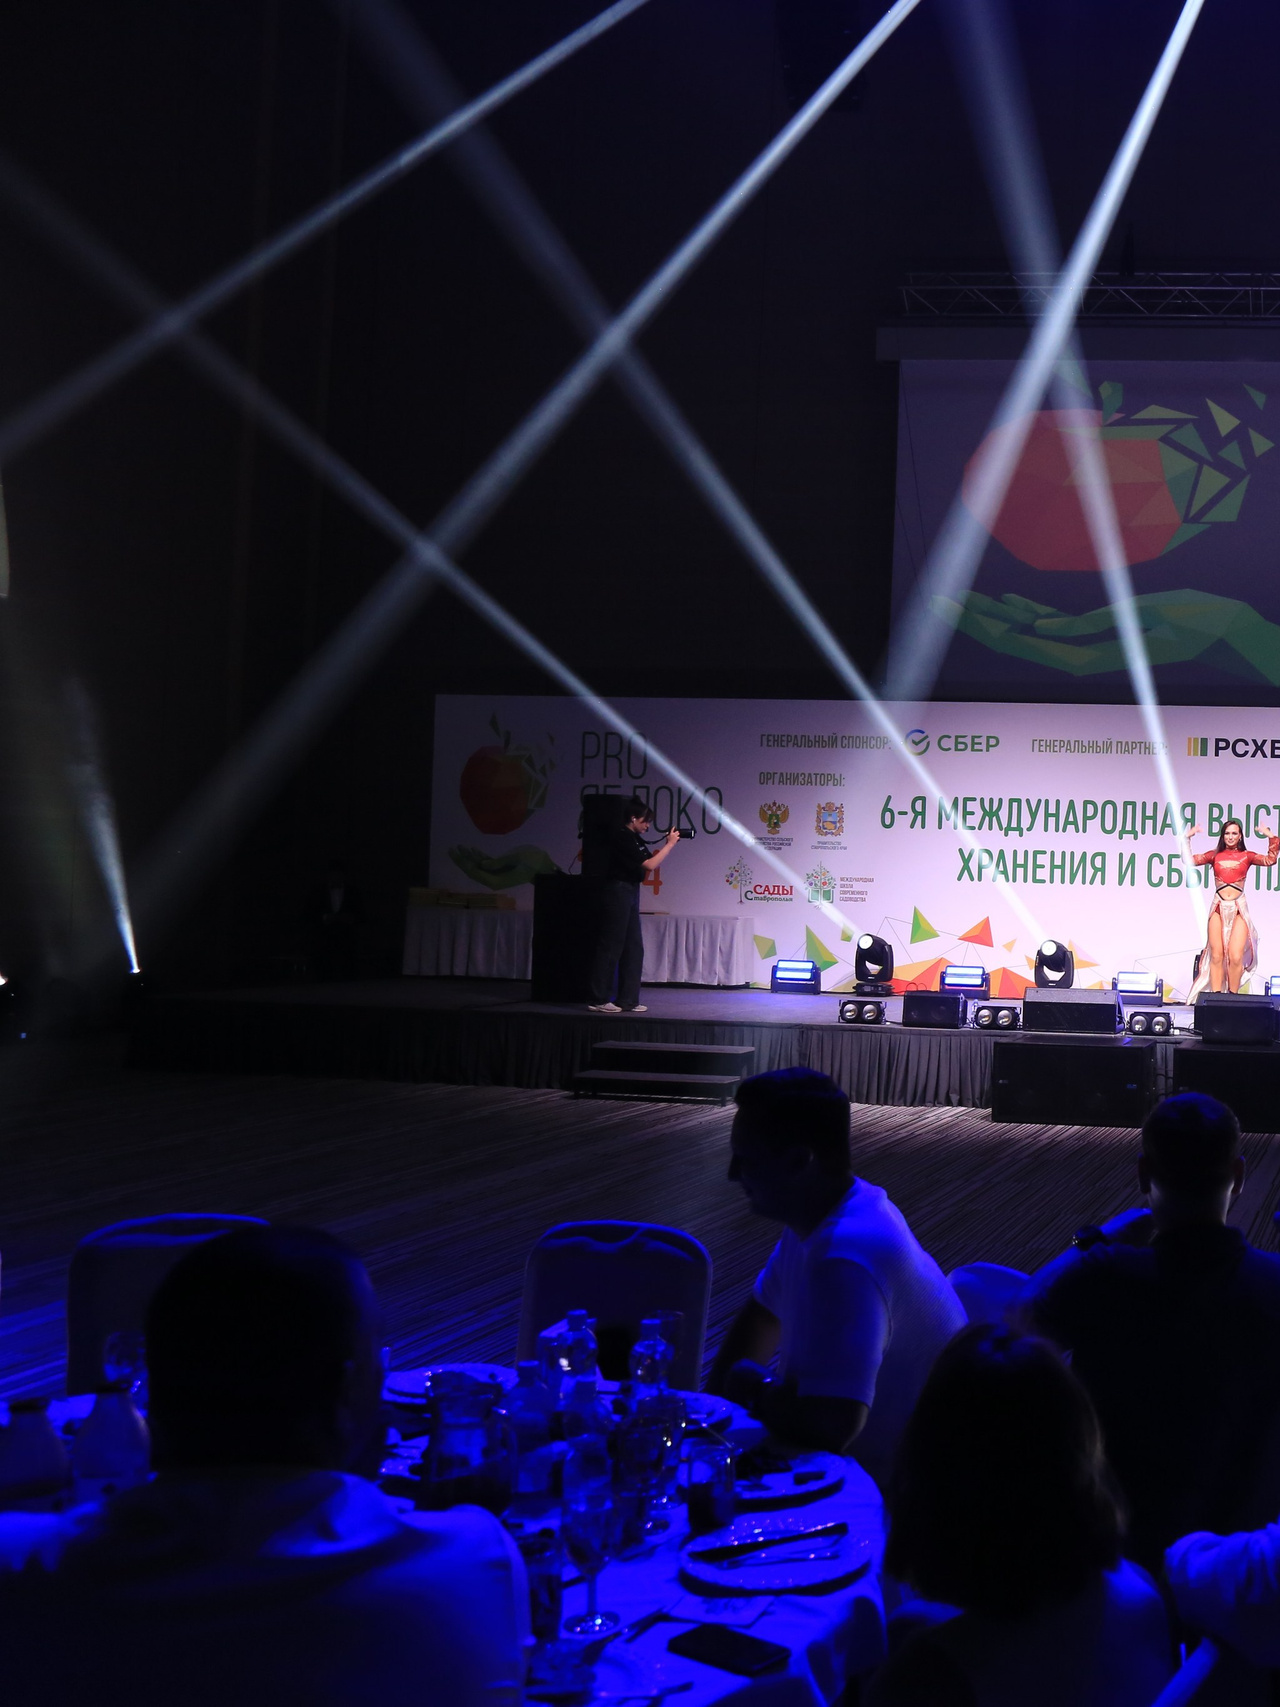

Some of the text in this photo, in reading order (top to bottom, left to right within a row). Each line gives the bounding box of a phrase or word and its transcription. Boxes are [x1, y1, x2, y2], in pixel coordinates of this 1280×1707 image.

[760, 732, 892, 750] ГЕНЕРАЛЬНЫЙ СПОНСОР:
[937, 734, 1000, 752] СБЕР
[1031, 737, 1113, 755] ГЕНЕРАЛЬНЫЙ
[580, 730, 649, 781] PRO
[758, 771, 846, 787] ОРГАНИЗАТОРЫ:
[880, 795, 927, 830] 6-Я
[937, 796, 1197, 840] МЕЖДУНАРОДНАЯ
[957, 847, 1107, 886] ХРАНЕНИЯ
[1117, 851, 1136, 886] И
[753, 884, 794, 896] САДЫ
